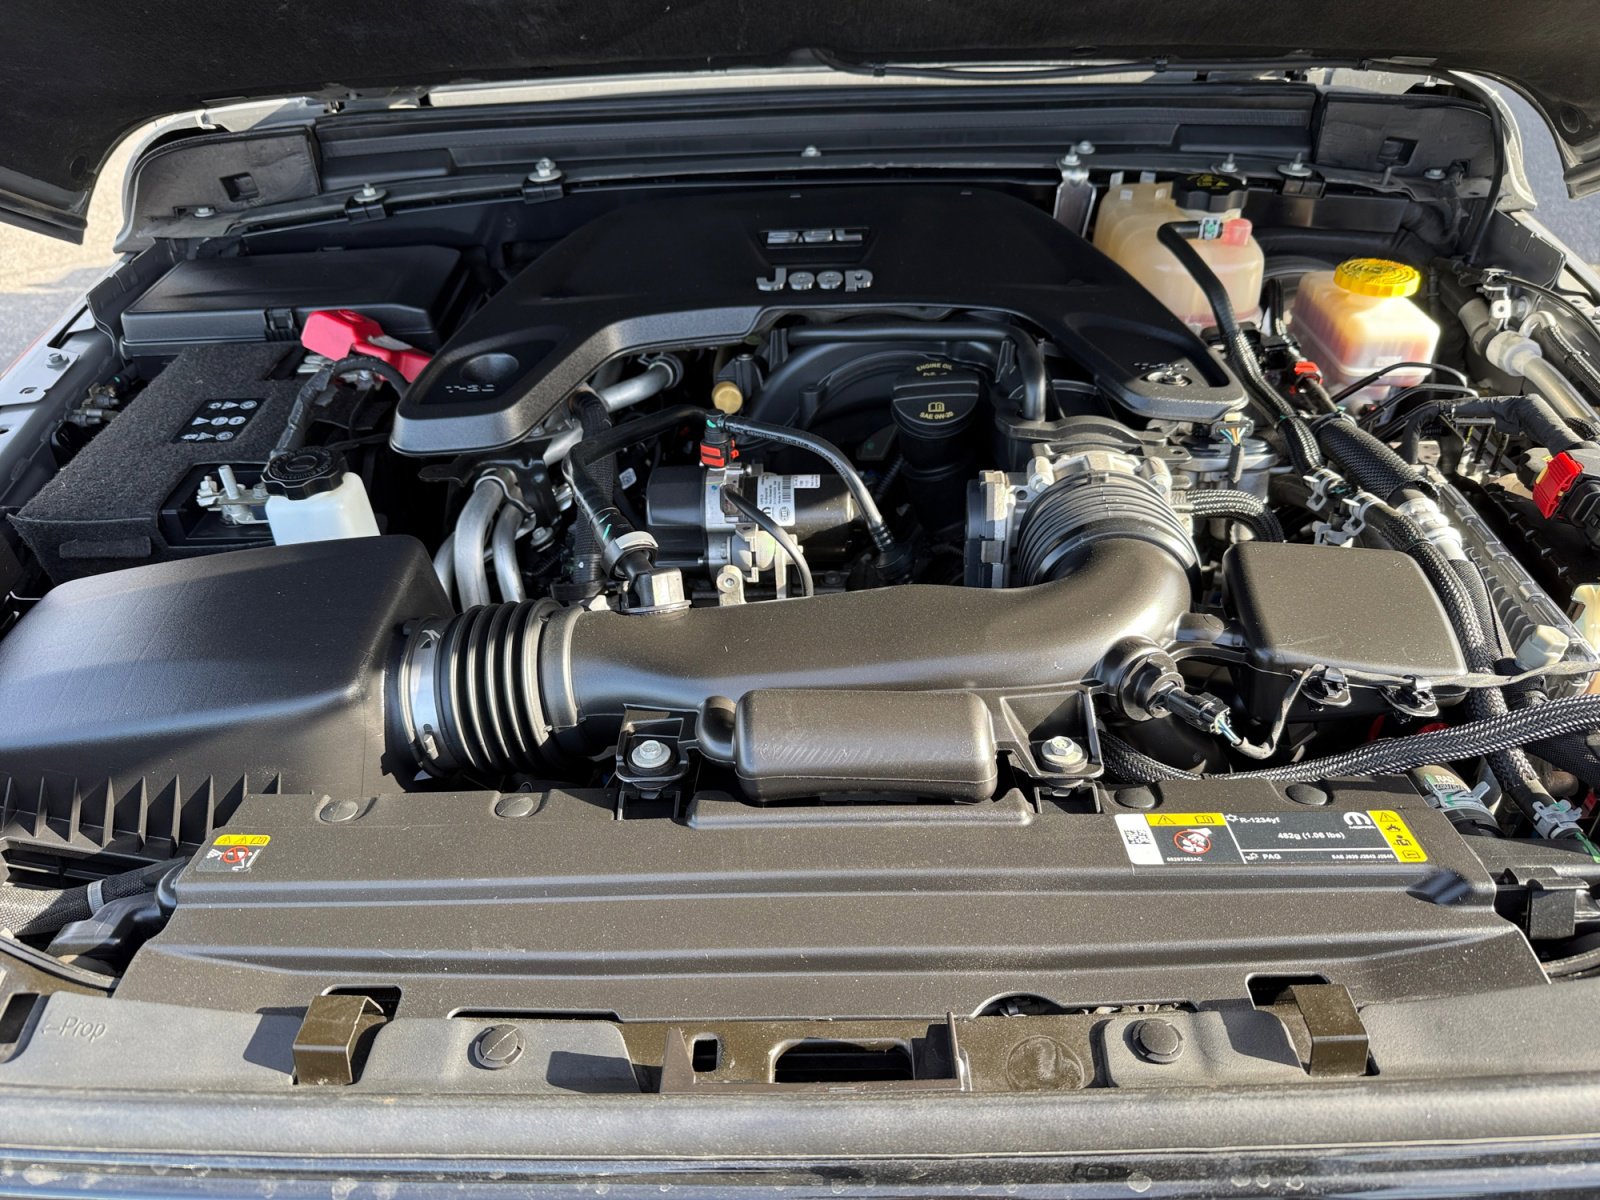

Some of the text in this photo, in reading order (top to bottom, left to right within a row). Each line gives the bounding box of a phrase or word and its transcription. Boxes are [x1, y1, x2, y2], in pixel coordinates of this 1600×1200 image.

[756, 267, 874, 292] Jeep
[916, 362, 953, 372] ENGINE OIL
[919, 411, 933, 419] SAE
[1239, 816, 1280, 825] R-1234yf
[1277, 832, 1302, 840] 482g
[1326, 831, 1346, 840] lbs)
[60, 1016, 107, 1043] Prop
